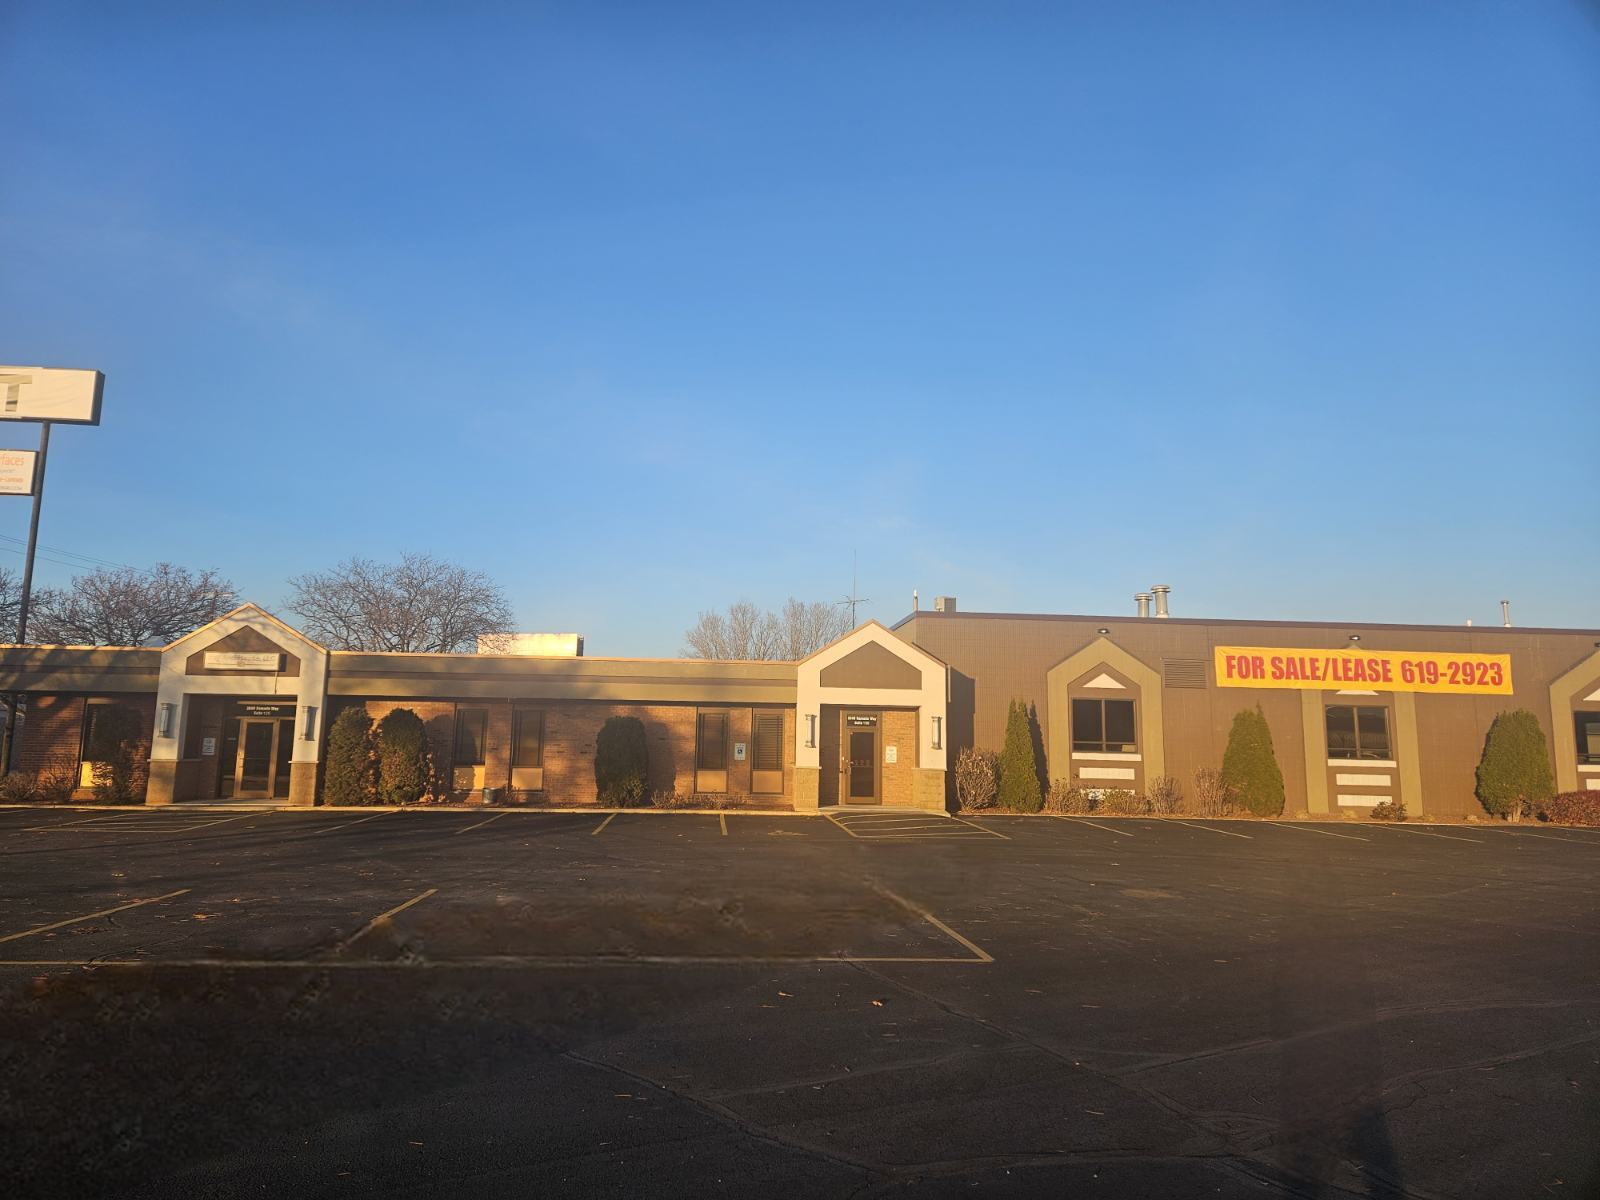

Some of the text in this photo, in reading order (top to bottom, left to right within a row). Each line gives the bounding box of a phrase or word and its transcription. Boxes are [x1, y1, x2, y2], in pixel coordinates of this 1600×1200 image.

[1226, 655, 1503, 686] FOR SALE/LEASE 619-2923
